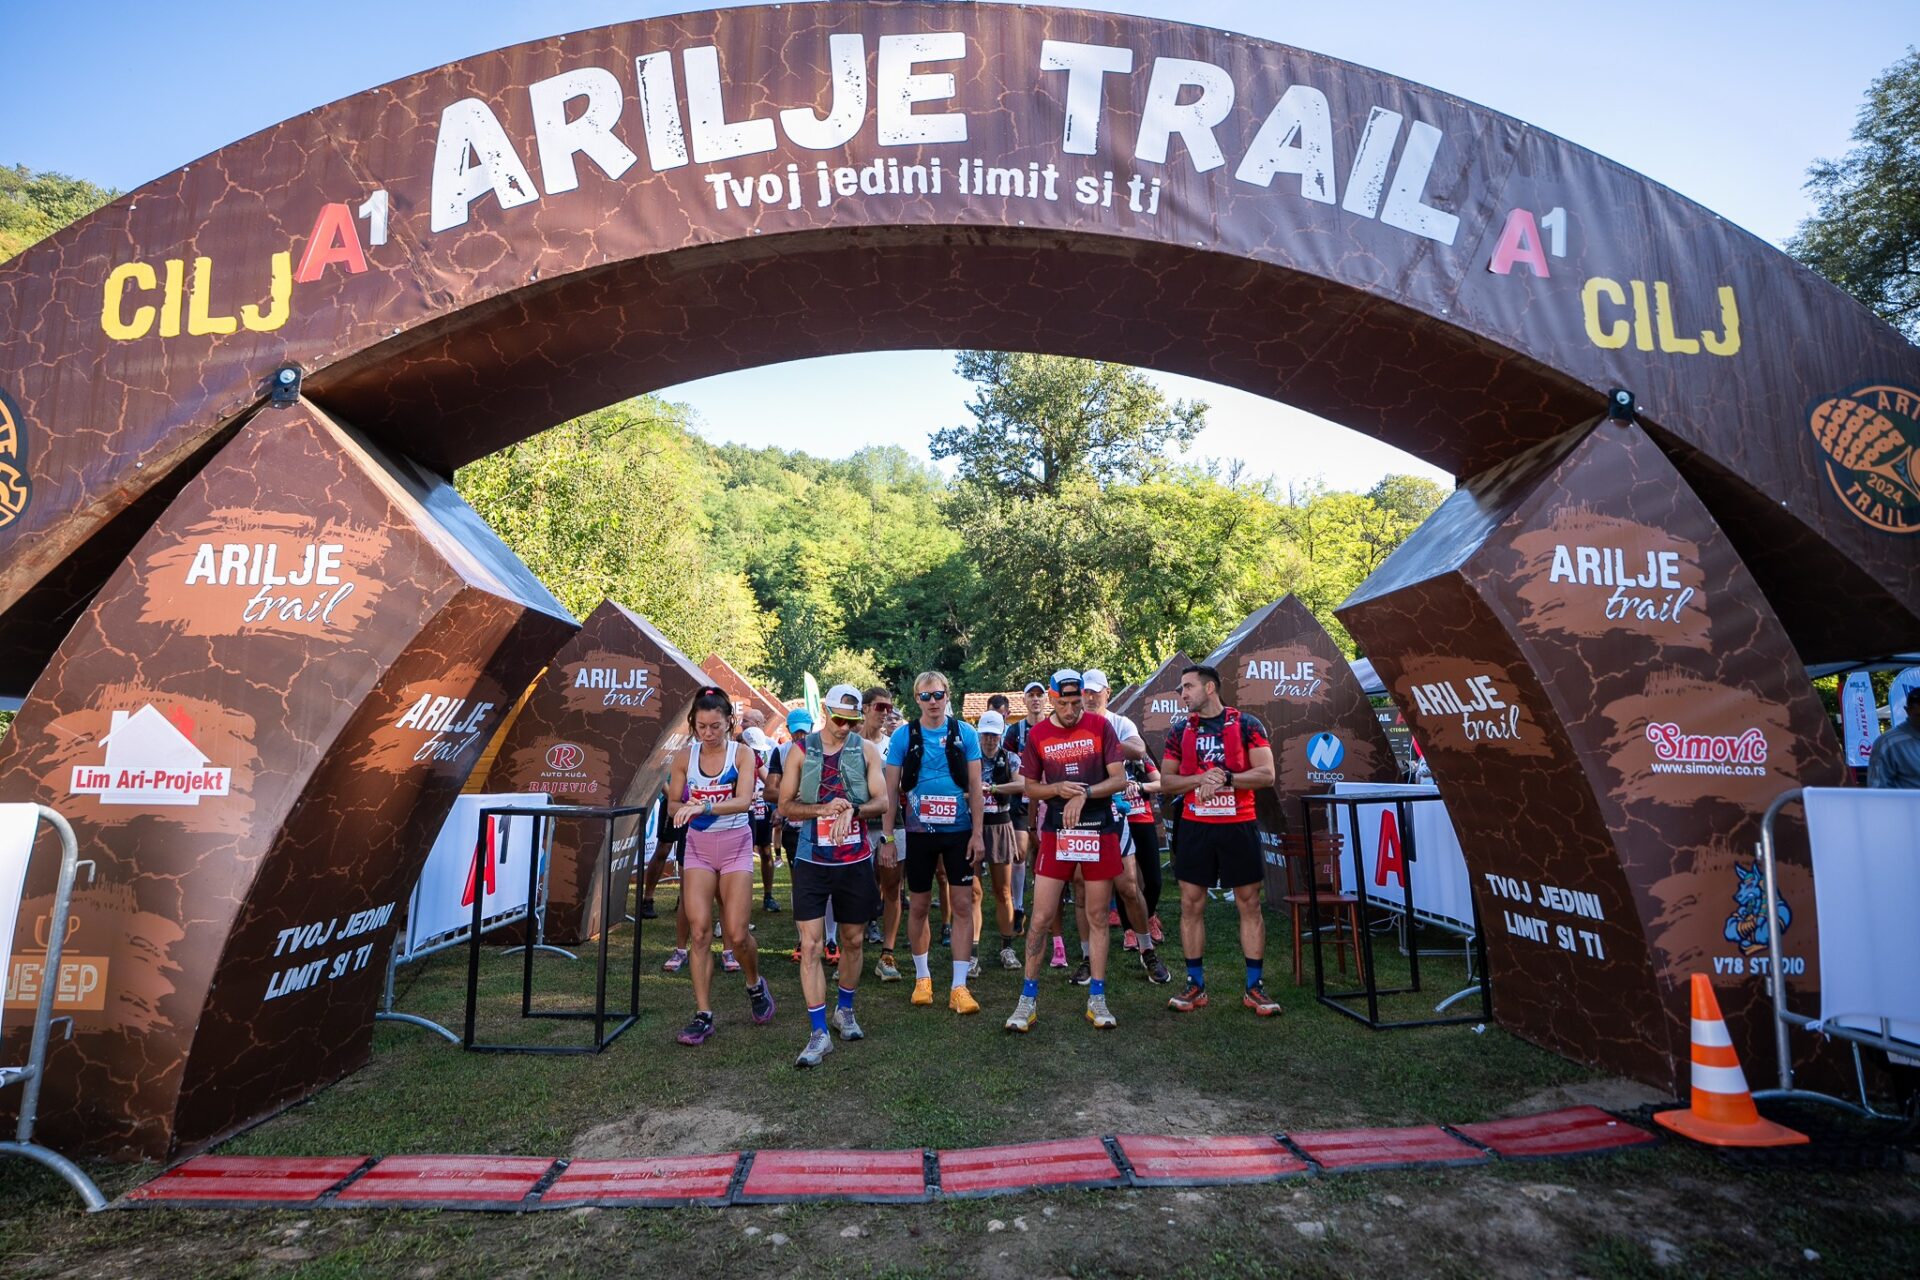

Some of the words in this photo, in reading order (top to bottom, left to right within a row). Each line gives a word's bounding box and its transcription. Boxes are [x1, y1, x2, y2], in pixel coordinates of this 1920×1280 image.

[430, 32, 968, 233] ARILJE
[1040, 39, 1460, 246] TRAIL
[704, 161, 801, 211] Tvoj
[817, 157, 941, 207] jedini
[958, 157, 1059, 201] limit
[1075, 170, 1114, 208] si
[1127, 177, 1161, 216] ti
[294, 189, 388, 283] A1
[1488, 206, 1567, 278] A1
[100, 250, 293, 341] CILJ
[1581, 277, 1741, 356] CILJ
[1846, 481, 1908, 528] TRAIL
[184, 543, 345, 585] ARILJE
[1549, 543, 1682, 590] ARILJE
[242, 581, 355, 625] trail
[1605, 584, 1695, 625] trail
[574, 667, 648, 690] ARILJE
[1246, 659, 1314, 681] ARILJE
[1274, 678, 1322, 698] trail
[395, 692, 495, 734] ARILJE
[602, 687, 655, 708] trail
[1150, 699, 1189, 713] ARILJ
[1410, 674, 1507, 717] ARILJE
[1196, 735, 1225, 751] RIL
[1461, 705, 1522, 742] trail
[413, 729, 482, 763] trail
[1044, 738, 1094, 754] DURMITOR
[76, 769, 111, 789] Lim
[116, 770, 223, 794] Ari-Projekt
[528, 780, 598, 794] RAJEVIĆ
[1651, 762, 1766, 776] www.simovic.co.rs
[928, 803, 957, 816] 3053
[1074, 820, 1102, 828] ALOMON
[1067, 838, 1100, 852] 3060
[1485, 873, 1532, 904] TVOJ
[1538, 884, 1605, 920] JEDINI
[274, 918, 338, 957] TVOJ
[336, 901, 397, 940] JEDINI
[1503, 910, 1548, 945] LIMIT
[1556, 925, 1577, 953] SI
[1578, 930, 1605, 960] TI
[5, 963, 98, 1002] JEEP
[264, 957, 329, 1001] LIMIT
[328, 950, 353, 979] SI
[353, 942, 374, 972] TI
[1713, 956, 1744, 975] V78
[1749, 956, 1805, 975] STDIO
